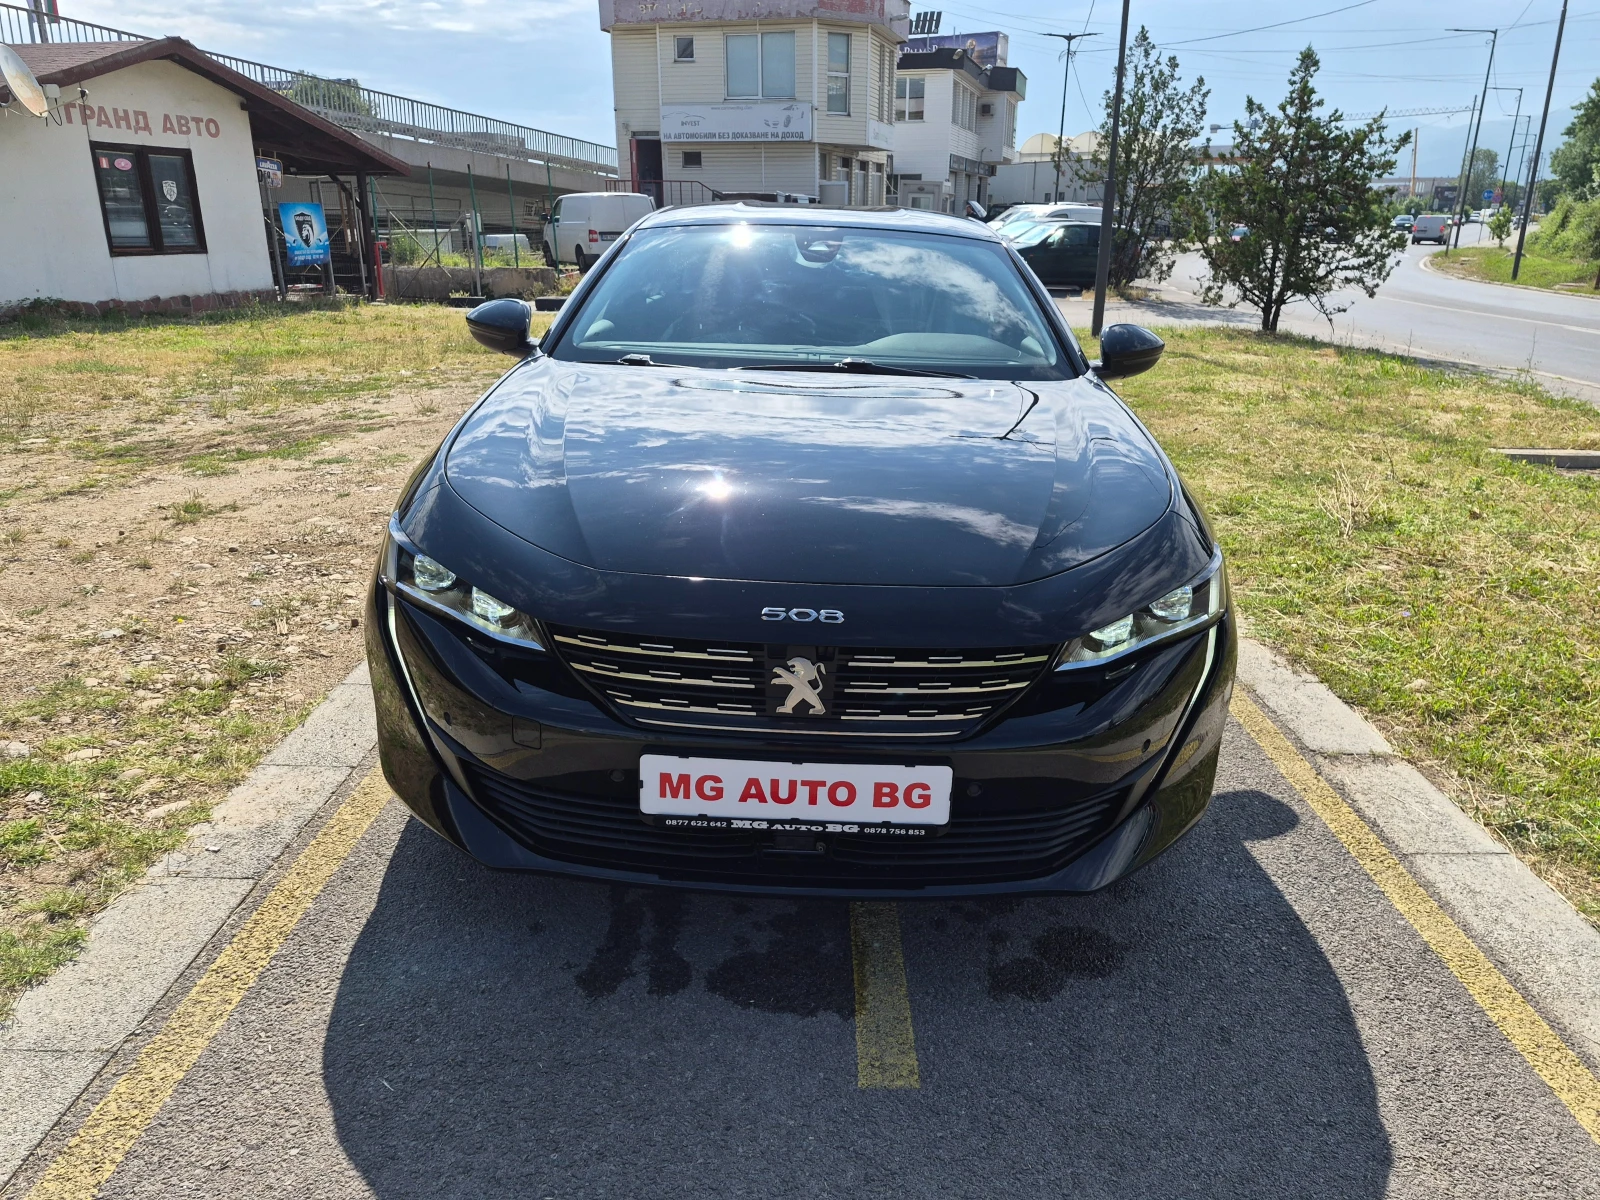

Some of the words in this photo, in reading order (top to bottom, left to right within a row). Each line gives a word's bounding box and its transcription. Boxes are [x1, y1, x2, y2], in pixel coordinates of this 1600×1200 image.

[63, 102, 153, 136] ГРАНД
[162, 113, 221, 138] АВТО
[673, 132, 717, 140] АВТОМОБИЛИ
[717, 131, 730, 139] БЕЗ
[731, 131, 770, 140] ДОКАЗВАНЕ
[770, 131, 780, 139] НА
[781, 131, 805, 140] ДОХОД
[760, 606, 845, 624] 508
[659, 772, 724, 802] MG
[738, 777, 857, 807] AUTO
[872, 782, 932, 809] BG
[730, 819, 769, 829] MG
[825, 823, 860, 833] BG
